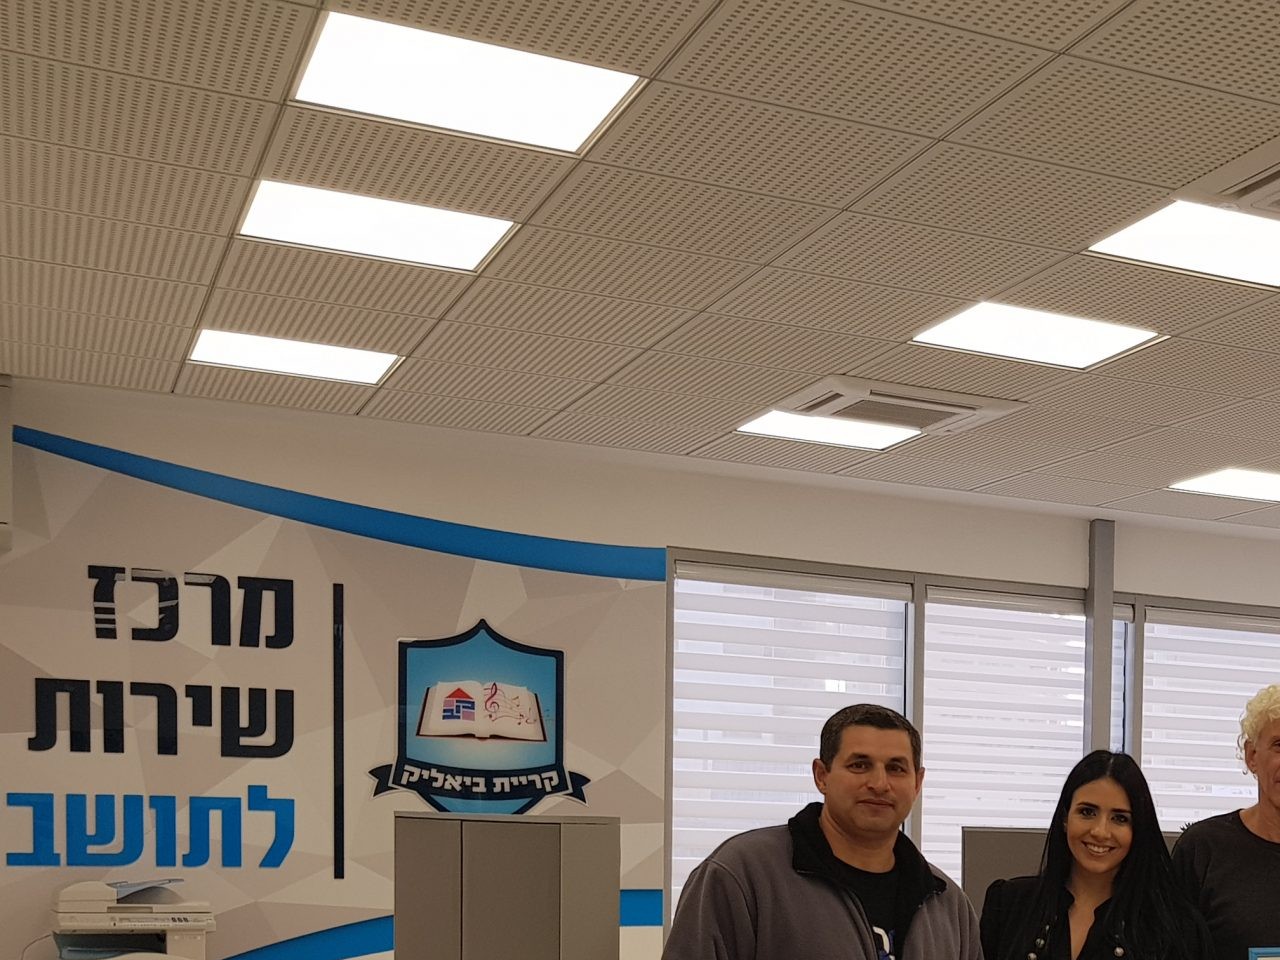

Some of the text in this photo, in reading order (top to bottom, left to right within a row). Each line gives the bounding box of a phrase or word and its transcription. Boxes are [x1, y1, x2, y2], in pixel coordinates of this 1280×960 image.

[88, 565, 294, 649] מרכז
[28, 678, 294, 758] שירות
[400, 764, 559, 793] קריית ביאליק
[6, 785, 294, 868] לתושב
